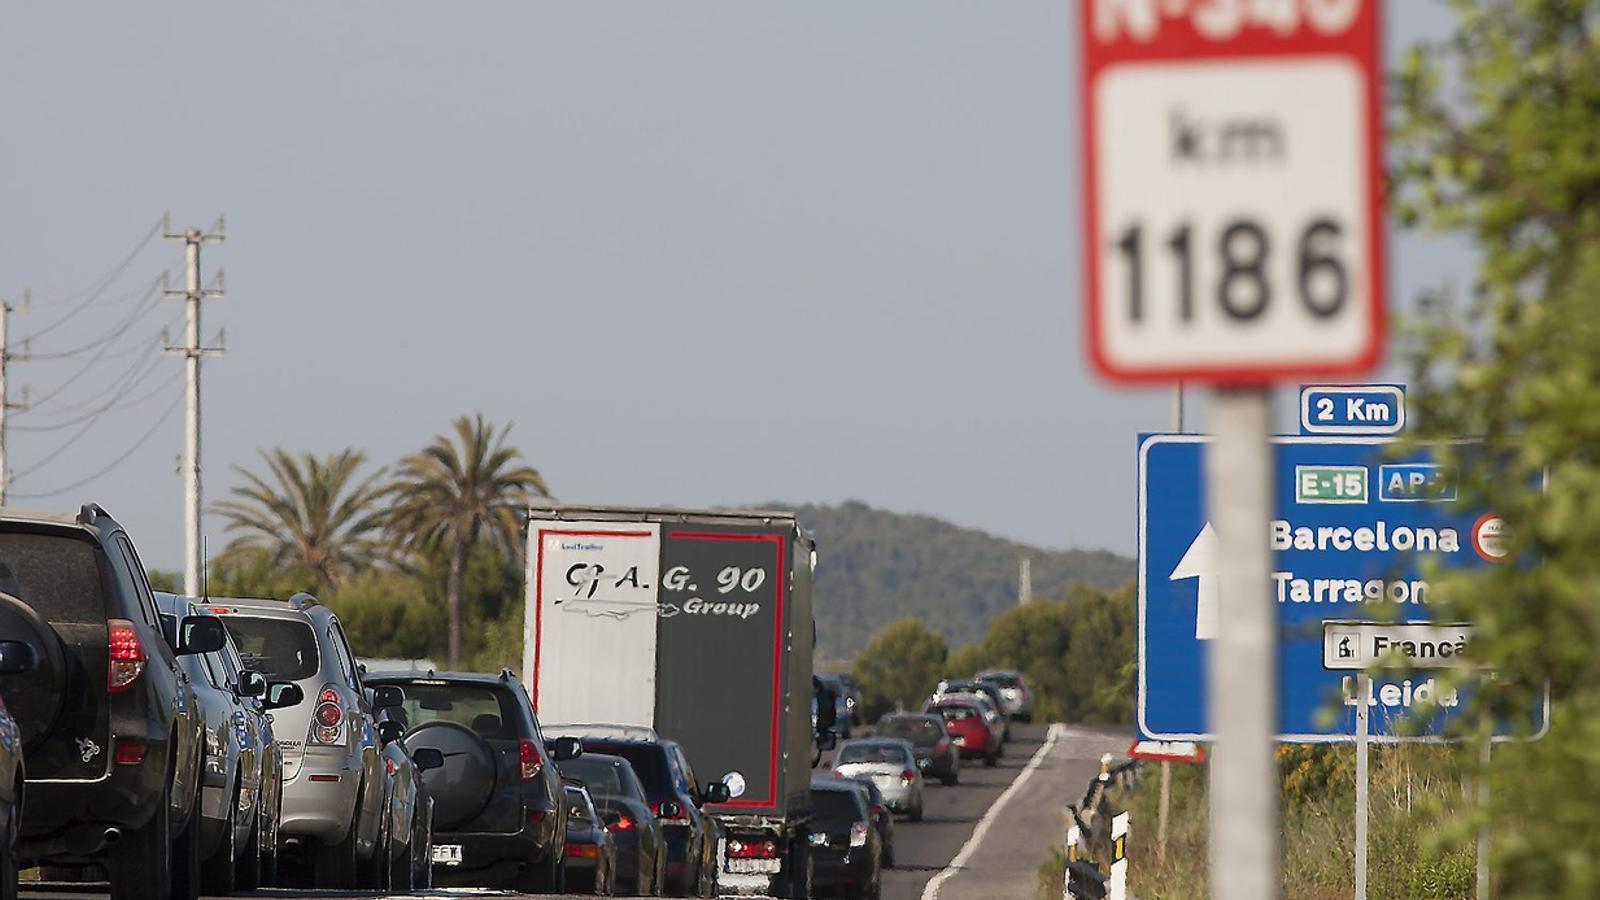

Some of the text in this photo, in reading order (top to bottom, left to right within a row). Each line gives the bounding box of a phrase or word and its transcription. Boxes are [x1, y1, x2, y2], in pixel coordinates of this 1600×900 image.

[1166, 102, 1288, 167] km
[1114, 217, 1350, 323] 1186
[1316, 398, 1389, 421] 2 Km
[1301, 473, 1362, 497] E-15
[1270, 519, 1461, 553] Barcelona
[662, 565, 698, 591] G.
[716, 566, 766, 594] 90
[1271, 571, 1432, 605] Tarragon
[683, 597, 760, 619] Group
[1373, 635, 1469, 659] Francà
